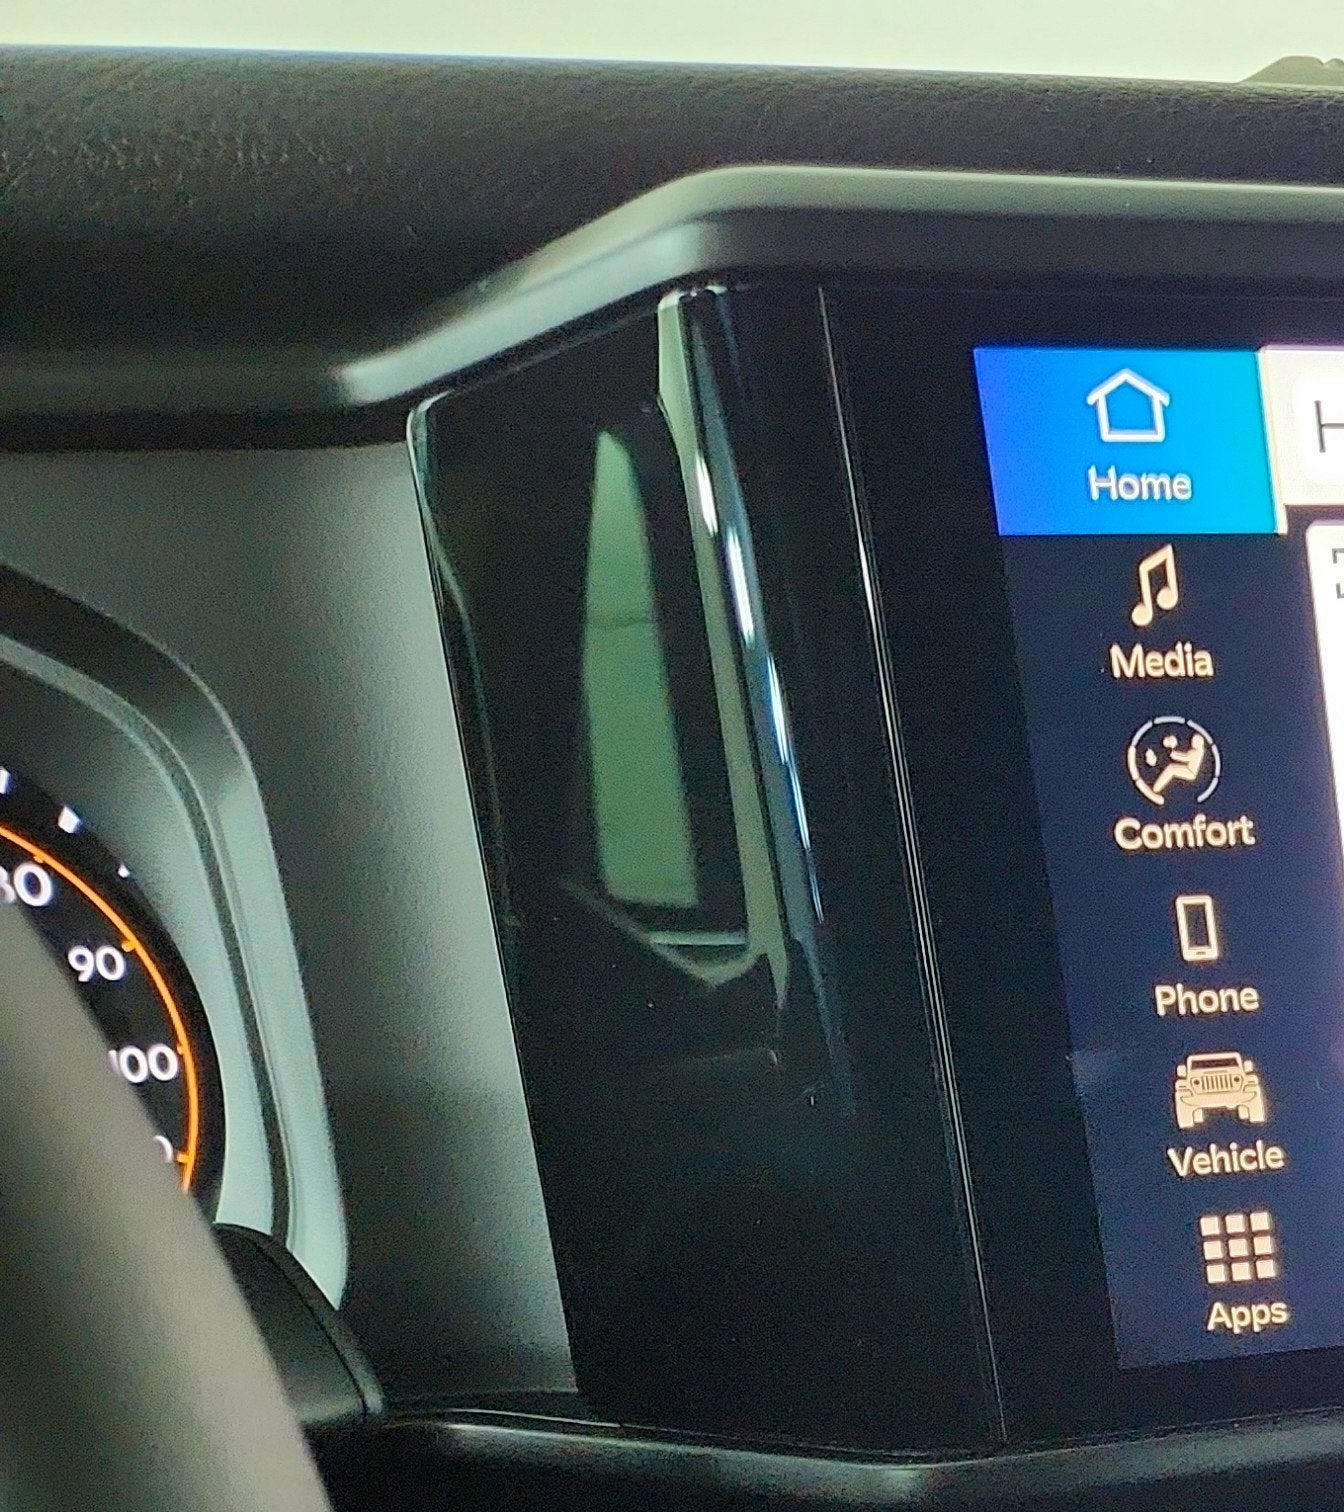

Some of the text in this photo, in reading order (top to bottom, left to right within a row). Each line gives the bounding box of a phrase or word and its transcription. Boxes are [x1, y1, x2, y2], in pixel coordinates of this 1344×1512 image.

[1088, 465, 1192, 503] Home
[1110, 642, 1214, 679] Media
[1113, 813, 1256, 851] Comfort
[67, 944, 127, 983] 90
[1155, 983, 1261, 1017] Phone
[1166, 1139, 1286, 1178] Vehicle
[1206, 1300, 1290, 1335] Apps
